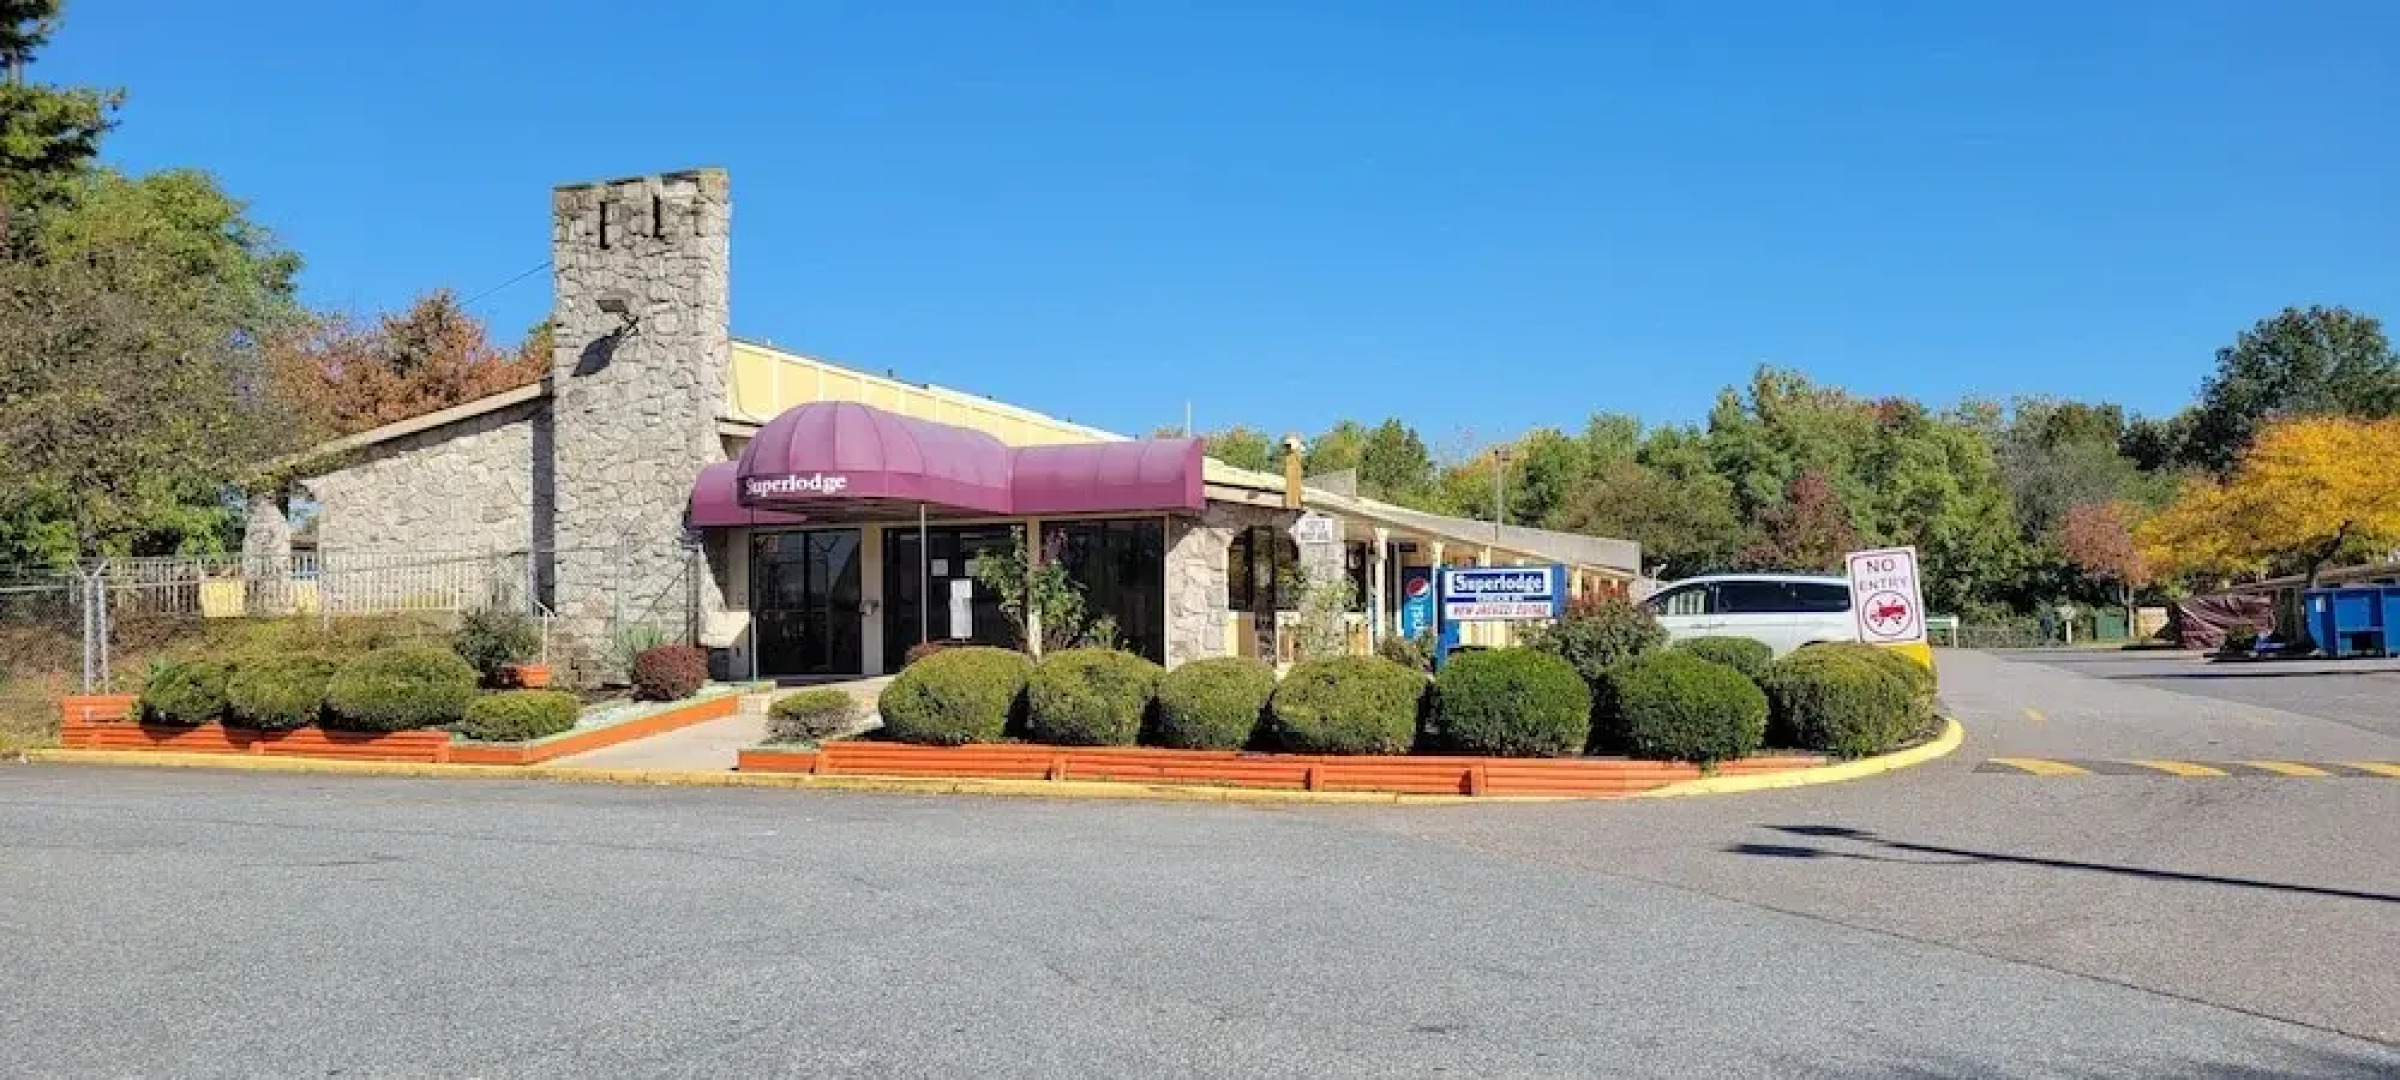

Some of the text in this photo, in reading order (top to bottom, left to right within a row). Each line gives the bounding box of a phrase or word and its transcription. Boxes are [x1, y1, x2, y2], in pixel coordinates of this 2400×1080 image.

[746, 473, 846, 498] Superlodge
[1866, 559, 1895, 573] NO
[1455, 575, 1543, 595] Superlodge
[1859, 576, 1909, 591] ENTRY
